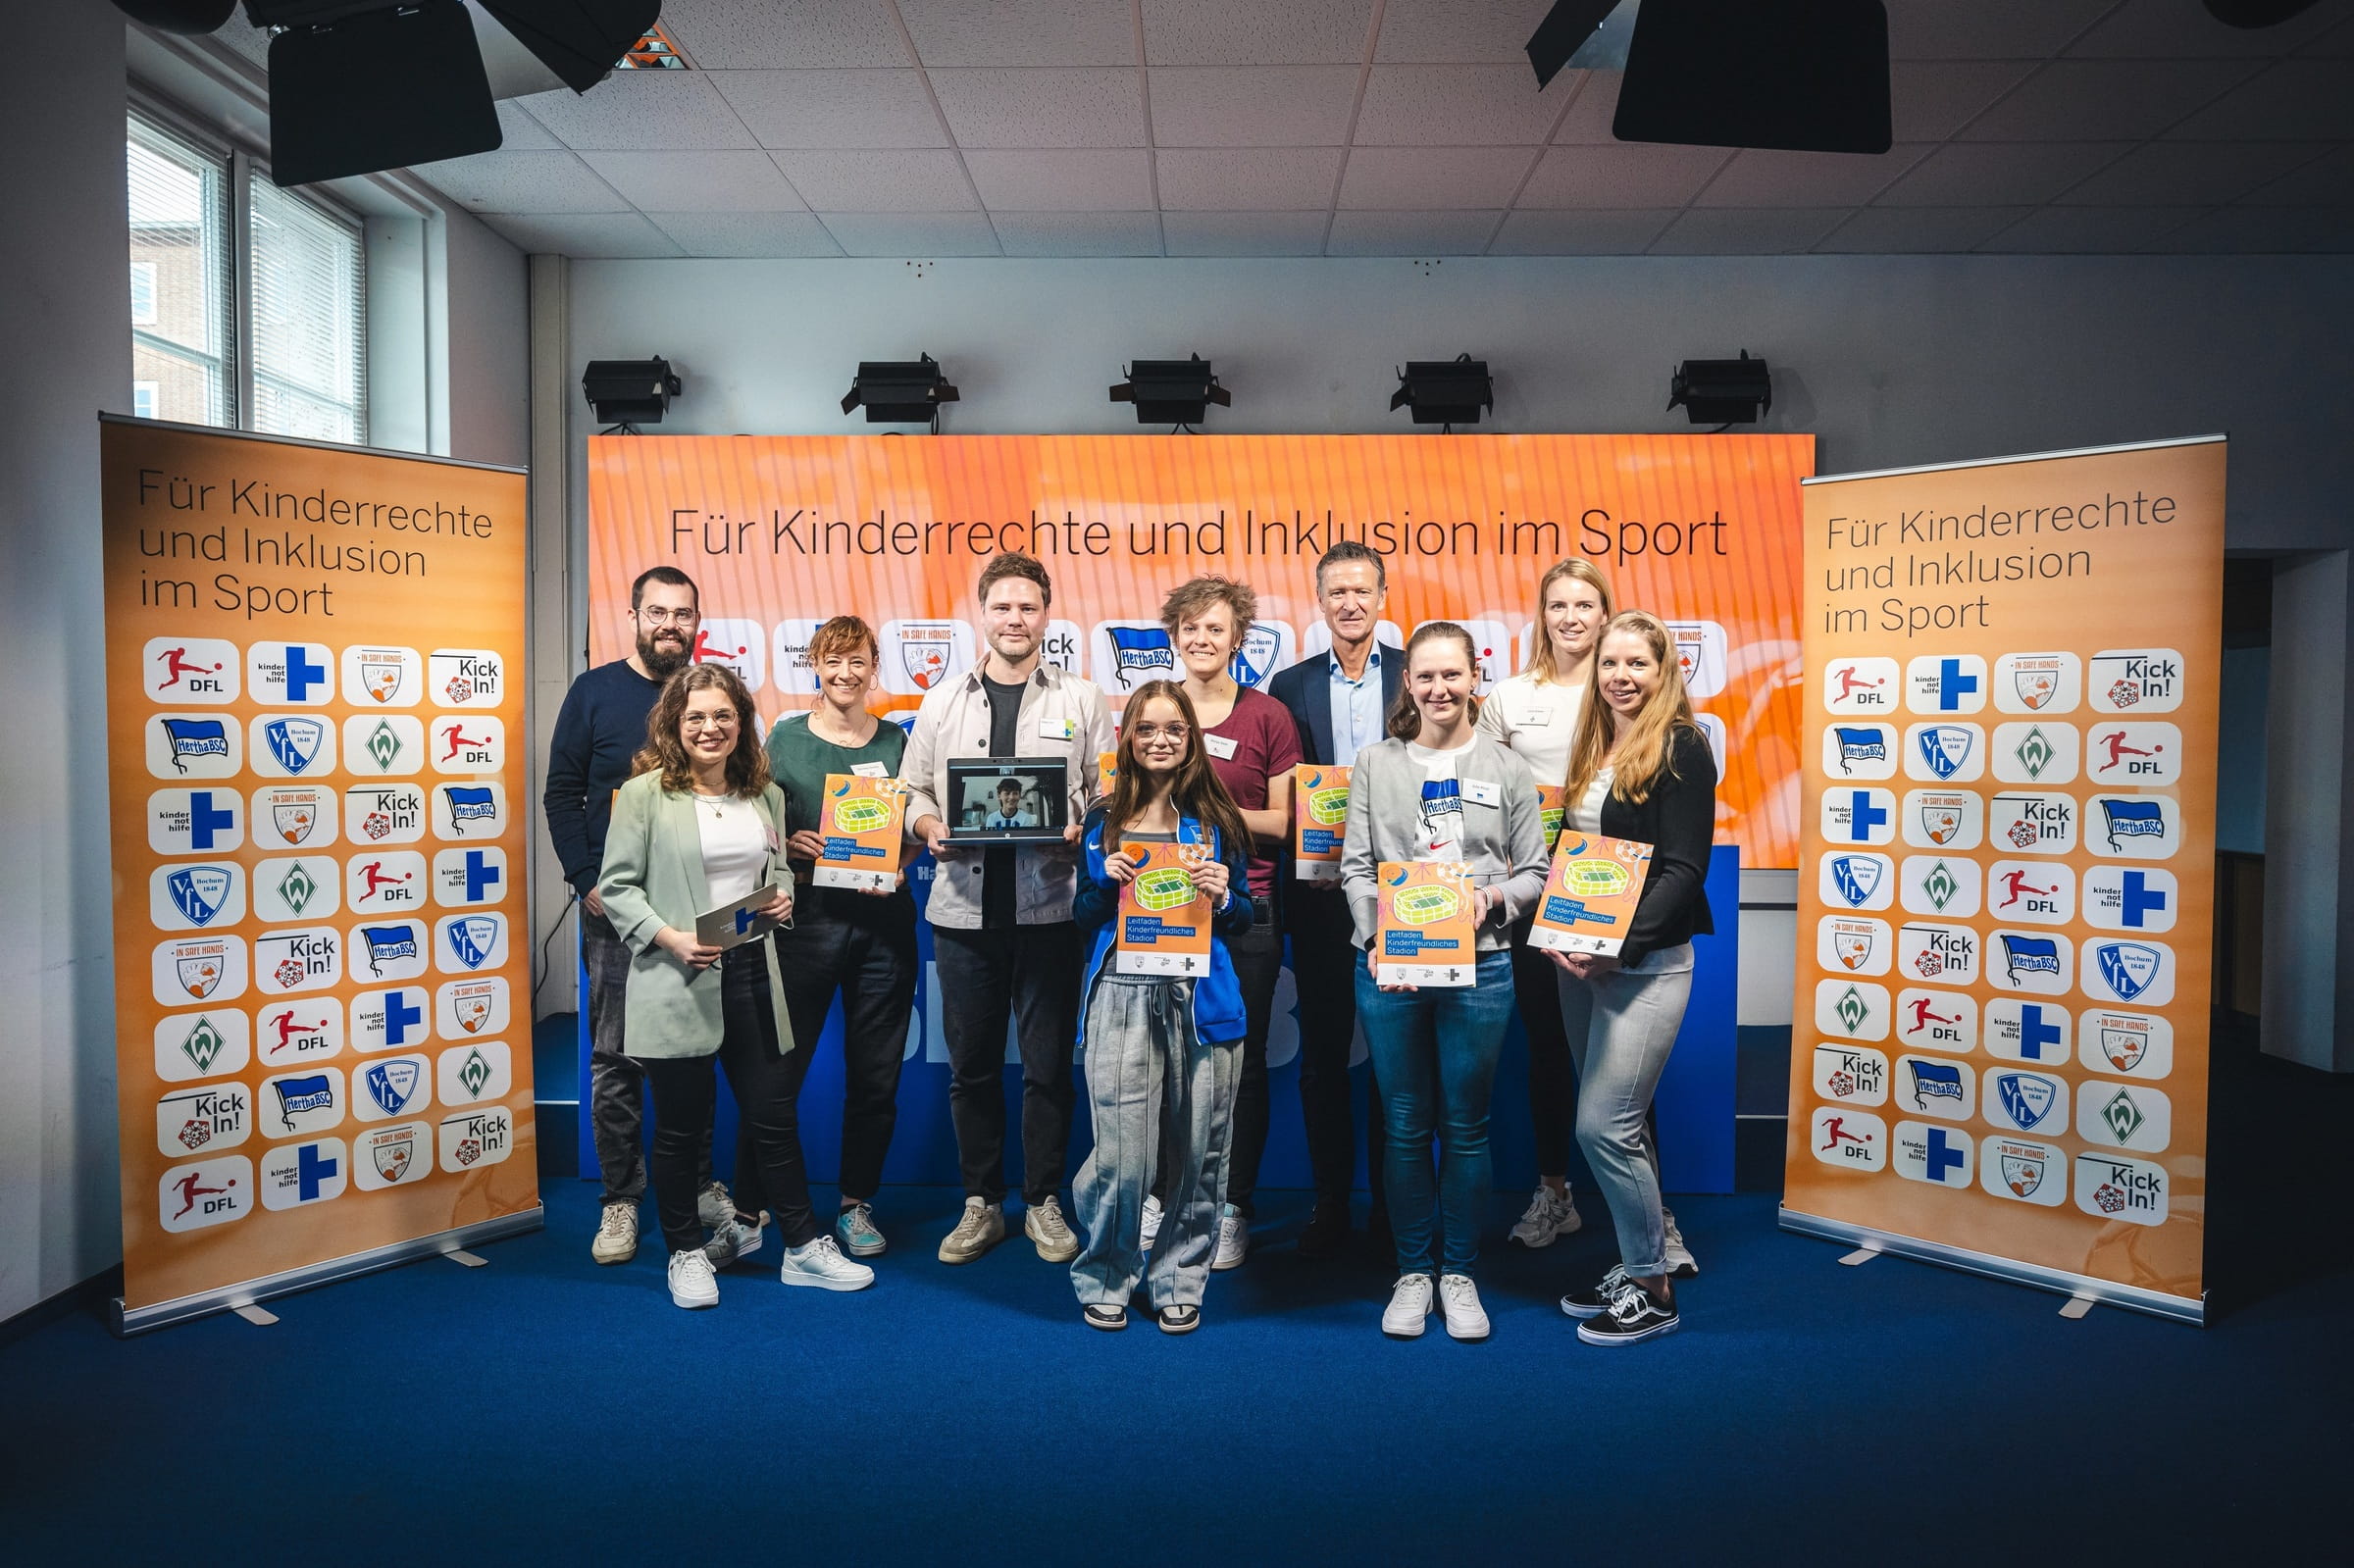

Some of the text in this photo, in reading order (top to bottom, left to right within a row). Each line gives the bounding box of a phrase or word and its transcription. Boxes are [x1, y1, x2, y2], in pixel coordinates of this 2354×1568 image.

[139, 469, 491, 539] Für Kinderrechte
[1829, 491, 2176, 549] Für Kinderrechte
[673, 510, 1727, 567] Für Kinderrechte und Inklusion im Sport
[138, 526, 428, 576] und Inklusion
[1827, 547, 2090, 591] und Inklusion
[141, 570, 333, 620] im Sport
[1827, 595, 1989, 638] im Sport
[1042, 633, 1075, 654] ick
[460, 660, 497, 676] Kick
[2126, 660, 2175, 678] Kick
[190, 680, 223, 692] DFL
[475, 677, 494, 693] In!
[2143, 679, 2170, 696] In!
[1858, 693, 1884, 704] DFL
[467, 752, 492, 762] DFL
[2129, 762, 2162, 774] DFL
[378, 794, 419, 811] Kick
[393, 811, 414, 828] In!
[2025, 803, 2070, 821] Kick
[2040, 821, 2064, 839] In!
[385, 889, 412, 900] DFL
[1550, 897, 1583, 909] Leitfaden
[1548, 904, 1613, 923] Kinderfreundliches
[2028, 900, 2058, 913] DFL
[1545, 912, 1573, 923] Stadion
[1127, 926, 1194, 935] Kinderfreundliches
[291, 938, 334, 957] Kick
[1931, 934, 1972, 953] Kick
[307, 956, 330, 974] In!
[1945, 952, 1967, 970] In!
[360, 1012, 384, 1021] kinder
[1994, 1018, 2020, 1027] kinder
[1933, 1028, 1961, 1041] DFL
[298, 1037, 328, 1050] DFL
[1844, 1055, 1882, 1076] Kick
[1857, 1074, 1877, 1092] In!
[196, 1095, 244, 1116] Kick
[214, 1112, 239, 1133] In!
[467, 1116, 506, 1135] Kick
[483, 1133, 502, 1151] In!
[1902, 1140, 1922, 1149] kinder
[1846, 1146, 1872, 1160] DFL
[1909, 1153, 1926, 1161] hilfe
[271, 1167, 297, 1176] kinder
[2111, 1166, 2161, 1194] Kick
[279, 1179, 298, 1188] hilfe
[204, 1197, 237, 1214] DFL
[2128, 1187, 2155, 1211] In!
